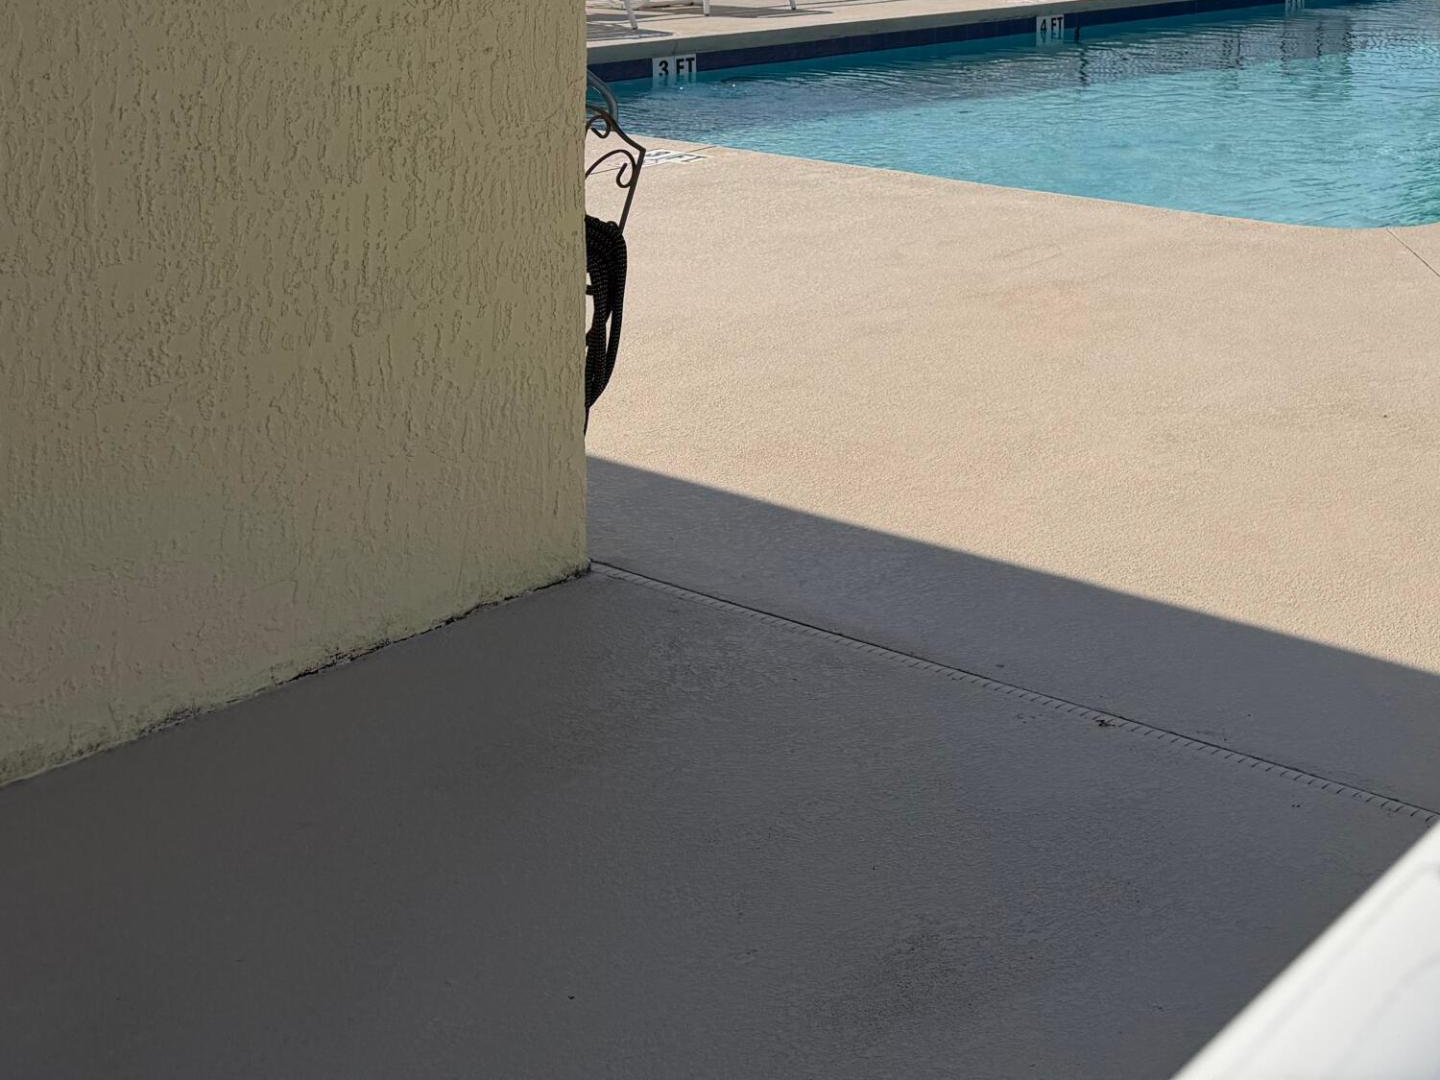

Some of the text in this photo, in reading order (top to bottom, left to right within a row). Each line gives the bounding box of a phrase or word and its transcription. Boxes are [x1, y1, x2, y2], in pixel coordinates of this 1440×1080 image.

[1040, 16, 1063, 33] 4 FT
[658, 57, 695, 77] 3 FT
